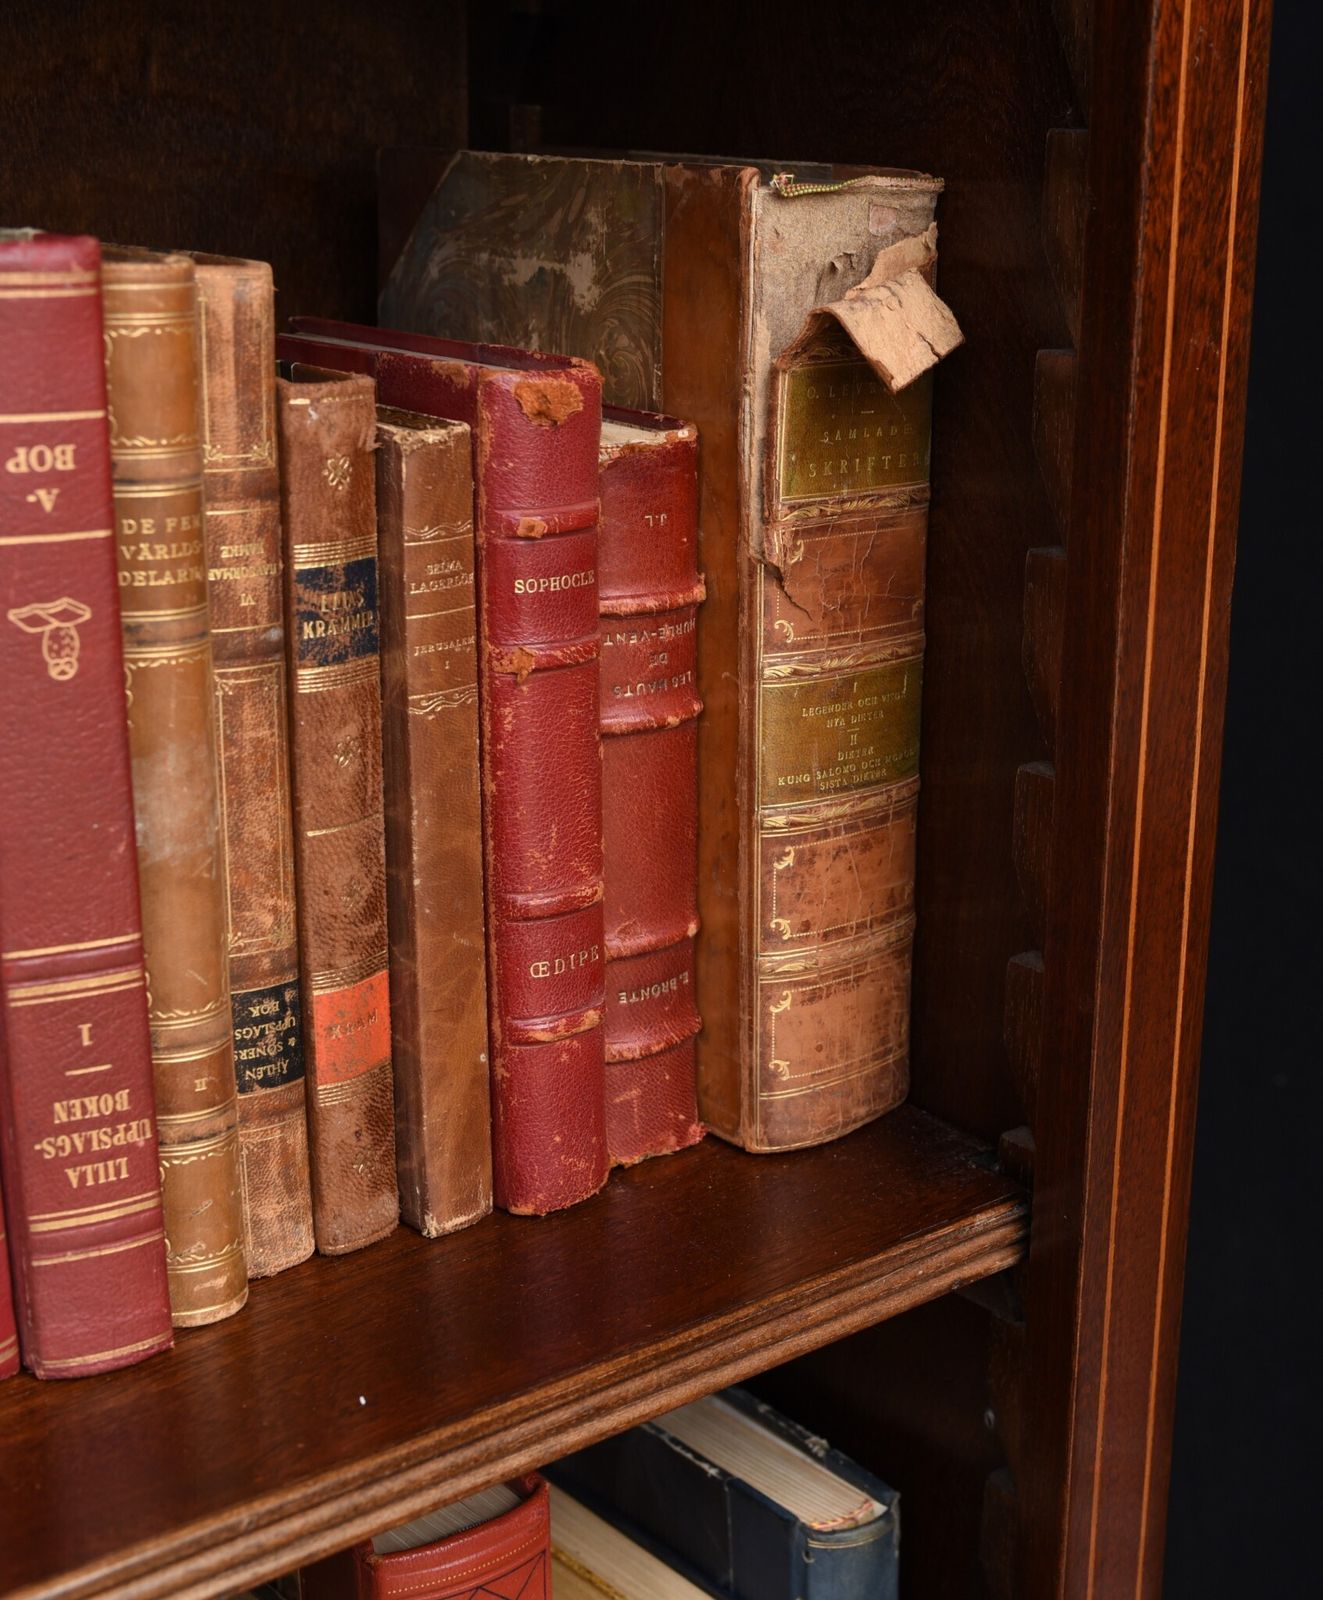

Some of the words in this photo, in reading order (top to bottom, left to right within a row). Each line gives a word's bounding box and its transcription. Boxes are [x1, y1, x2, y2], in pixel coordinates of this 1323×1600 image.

[822, 425, 913, 444] SAMLADE
[5, 444, 77, 474] BOP
[121, 518, 155, 536] DE
[426, 559, 463, 575] SELMA
[513, 569, 595, 595] SOPHOCLE
[603, 617, 697, 647] HURLE-VENT
[648, 652, 668, 668] DE
[613, 677, 669, 699] HAUTS
[801, 701, 854, 717] LEGENDER
[857, 695, 878, 708] OCH
[826, 717, 846, 728] NYA
[850, 710, 884, 724] DIKTER
[837, 746, 875, 762] DIKTER
[777, 773, 811, 786] KUNG
[815, 763, 857, 780] SALOMO
[861, 758, 881, 770] OCH
[819, 777, 848, 791] SISTA
[529, 944, 600, 978] ŒDIPE
[618, 979, 678, 1005] BRONTE
[248, 999, 280, 1018] BOK
[194, 1078, 209, 1092] II
[53, 1088, 131, 1124] BOKEN
[34, 1118, 153, 1160] UPPSLAGS-
[64, 1157, 130, 1188] LILLA
